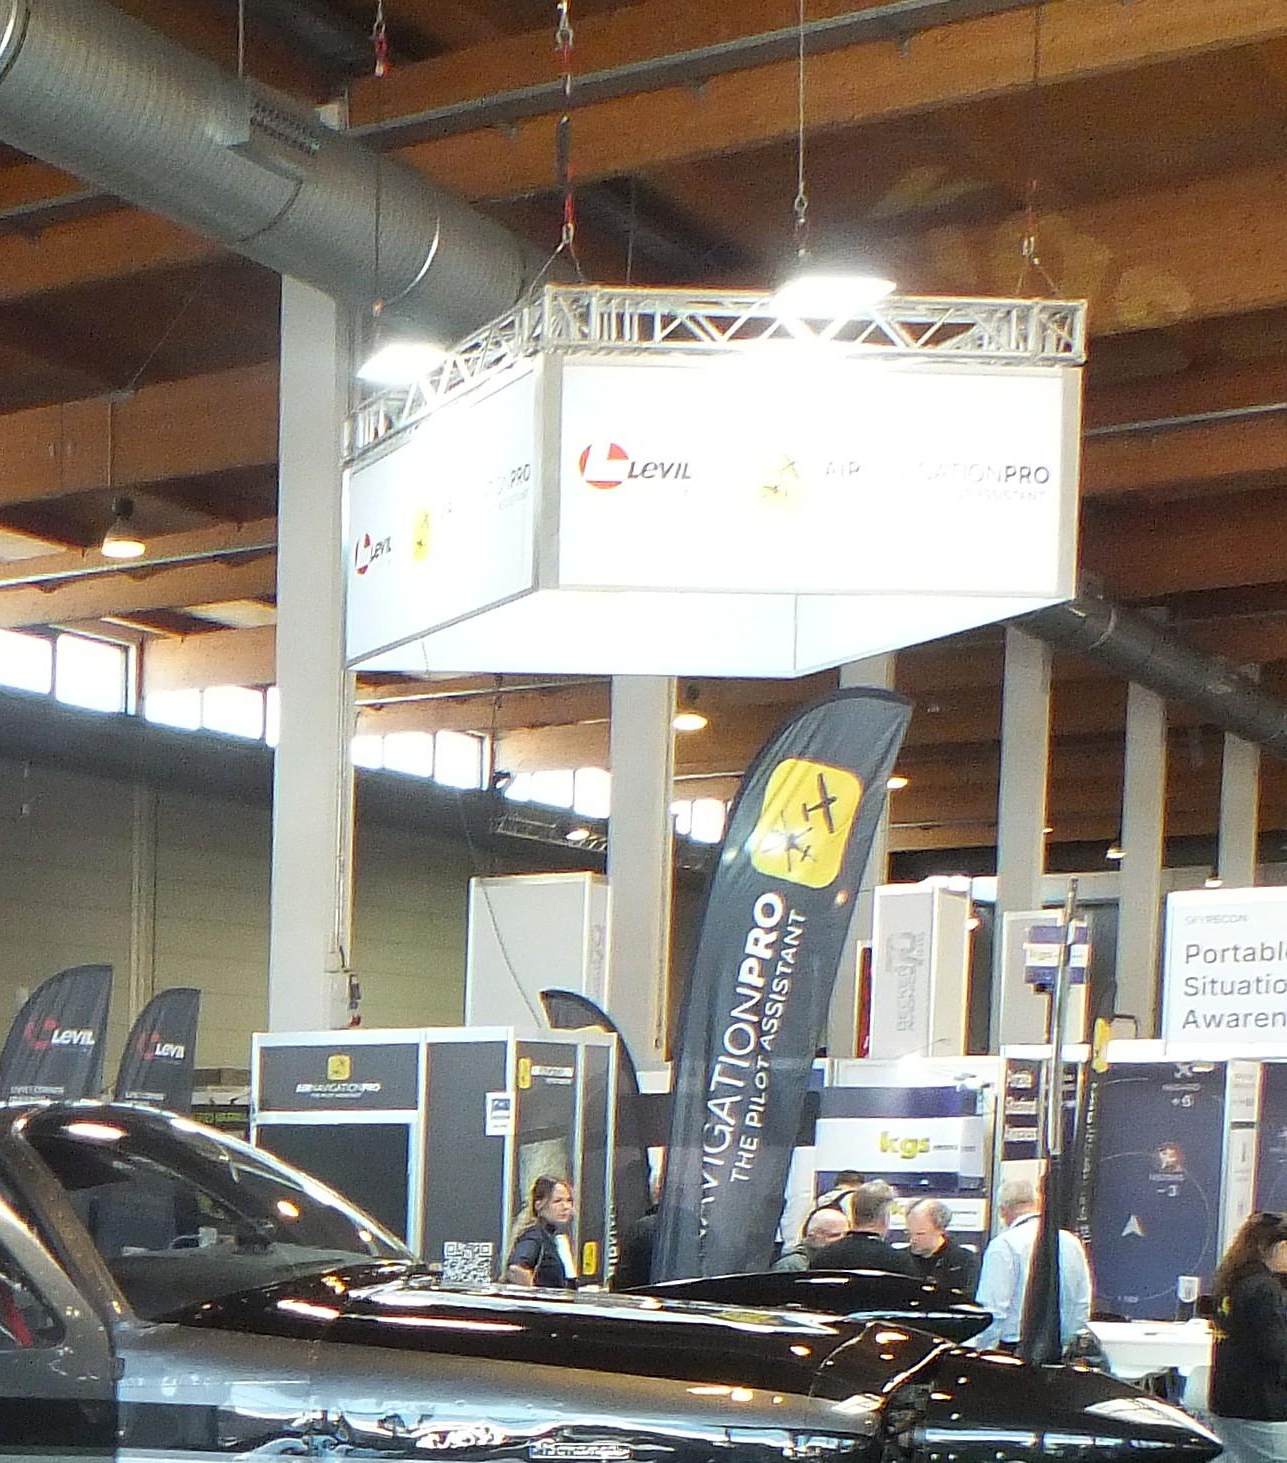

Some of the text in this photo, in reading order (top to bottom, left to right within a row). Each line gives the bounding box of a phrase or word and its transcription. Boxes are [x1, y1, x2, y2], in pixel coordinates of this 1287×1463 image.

[1185, 941, 1287, 964] Portabl
[730, 908, 809, 1183] THE PILOT ASSISTANT
[880, 1131, 930, 1159] kgs
